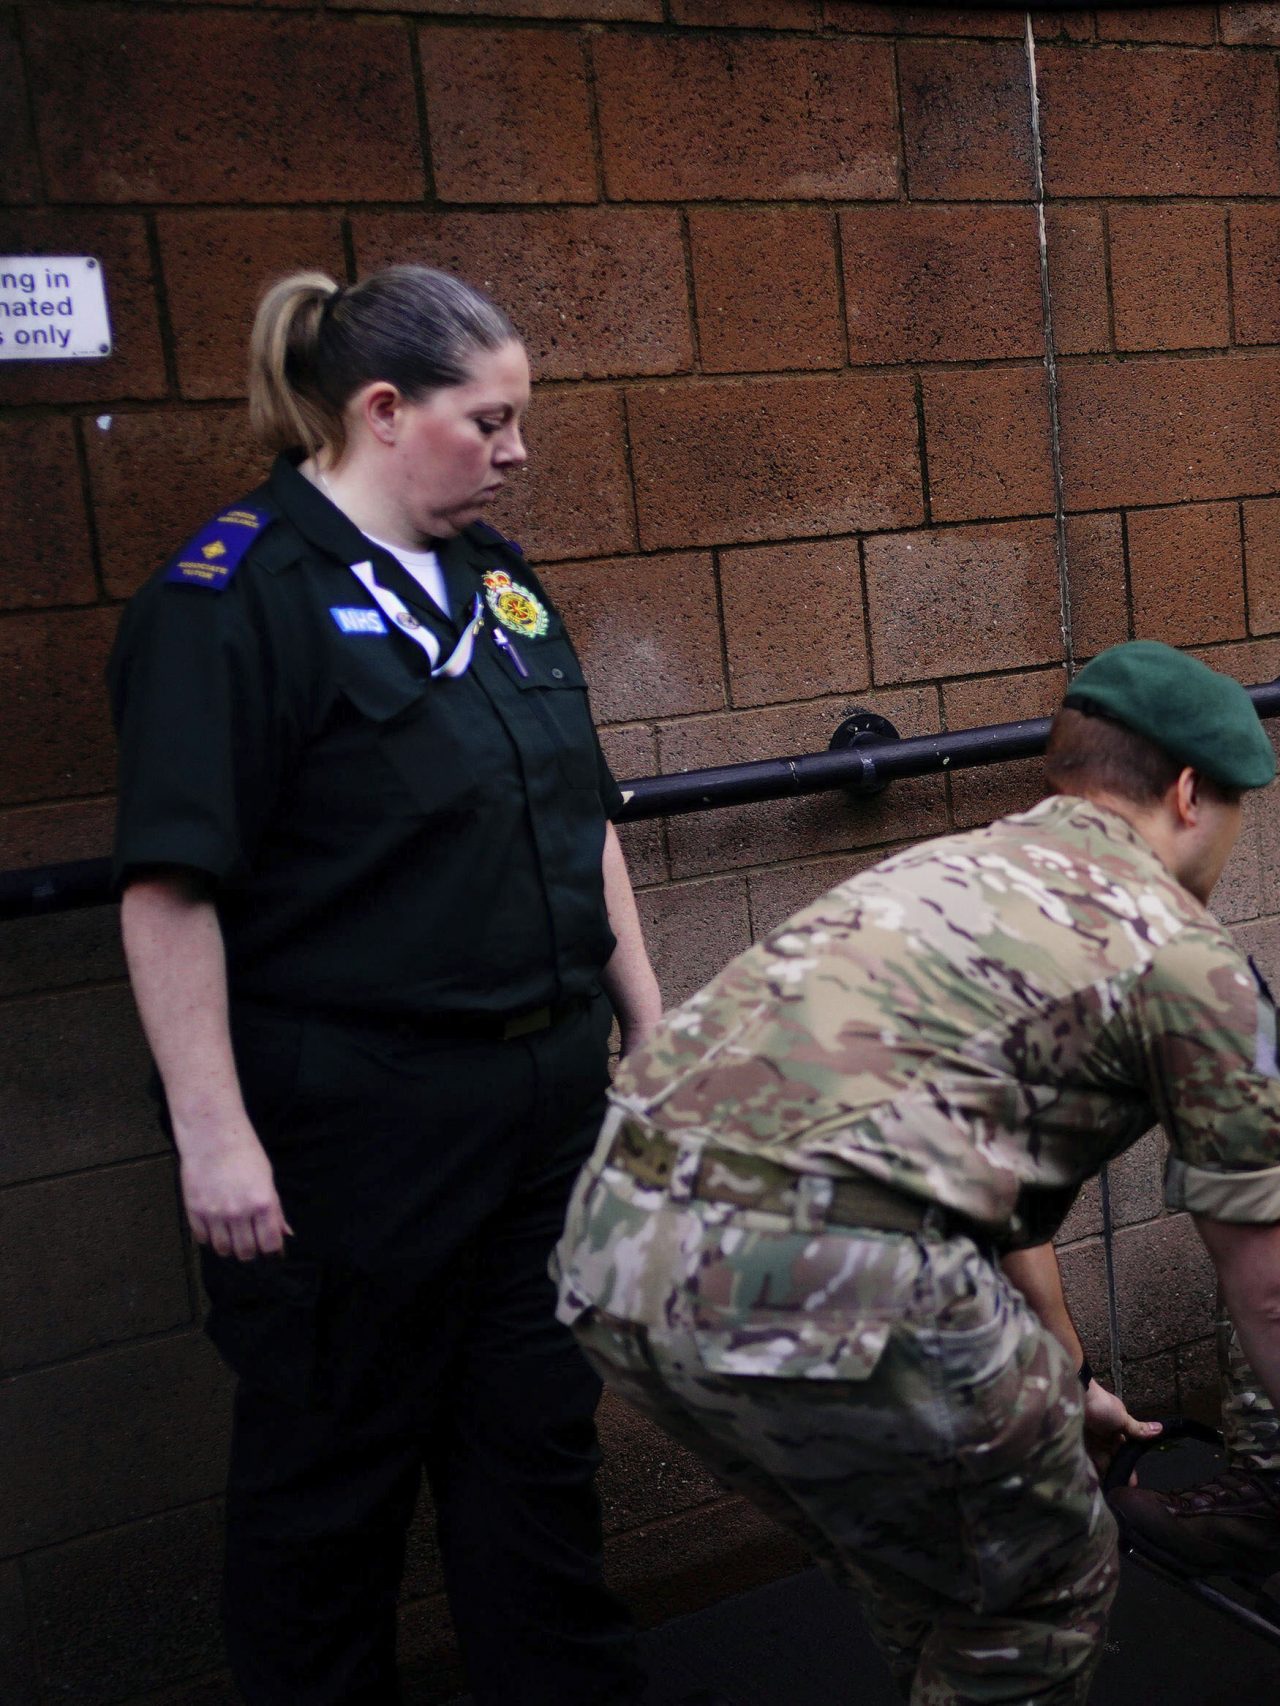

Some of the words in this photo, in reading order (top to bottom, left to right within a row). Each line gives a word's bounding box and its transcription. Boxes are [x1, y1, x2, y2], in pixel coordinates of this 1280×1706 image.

[45, 268, 70, 288] in
[14, 325, 71, 348] only
[338, 609, 383, 633] NHS
